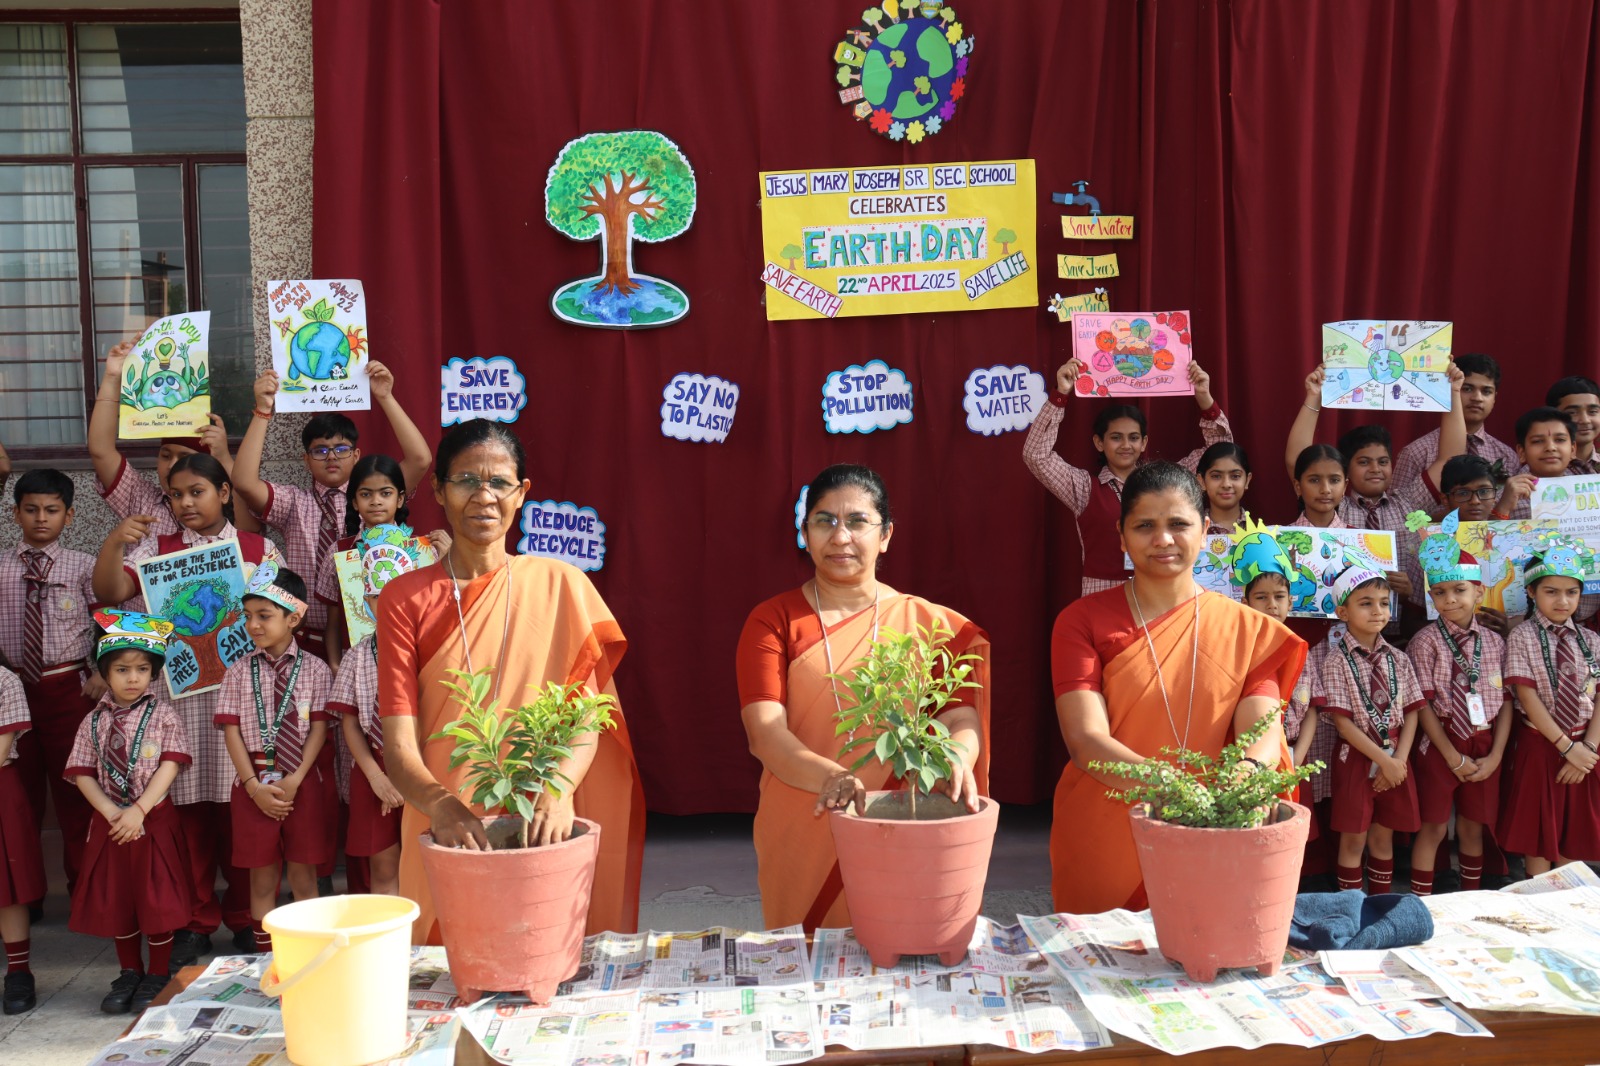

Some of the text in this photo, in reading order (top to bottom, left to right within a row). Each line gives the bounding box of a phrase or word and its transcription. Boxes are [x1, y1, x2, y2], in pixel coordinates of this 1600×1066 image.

[766, 164, 1015, 196] JESUS MARY JOSEPH SR. SEC. SCHOOL
[850, 196, 946, 215] CELEBRATES
[1064, 217, 1132, 237] Save Water
[803, 223, 986, 270] EARTH DAY
[965, 253, 1030, 299] SAVE LIFE
[1061, 256, 1085, 277] Save
[269, 279, 291, 302] HAPPY
[762, 263, 842, 317] SAVE EARTH
[868, 271, 921, 292] APRIL
[921, 273, 955, 290] 2025
[275, 282, 306, 313] EARTH
[337, 297, 354, 313] 22
[179, 317, 202, 345] Day
[1078, 331, 1097, 339] EARTH
[1080, 318, 1101, 328] SAVE
[460, 365, 509, 388] SAVE
[838, 373, 888, 394] STOP
[974, 372, 1027, 397] SAVE
[1105, 376, 1169, 389] HAPPY EARTH DAY
[447, 392, 522, 412] ENERGY
[673, 380, 735, 409] SAY NO
[826, 393, 912, 418] POLLUTION
[976, 394, 1033, 418] WATER
[667, 403, 734, 434] TO PLASTIC
[1574, 482, 1600, 494] EART
[1575, 493, 1600, 511] DA
[530, 507, 596, 534] REDUCE
[1560, 517, 1573, 525] AN'T
[372, 548, 409, 568] EARTH
[527, 532, 599, 560] RECYCLE
[141, 547, 231, 574] TREES ARE THE ROOT
[150, 576, 159, 586] OF
[181, 556, 237, 577] EXISTENCE
[1297, 556, 1323, 578] PLANET
[220, 626, 248, 656] SAV
[1539, 629, 1548, 648] SCHOOL
[168, 649, 193, 673] SAVE
[172, 661, 198, 685] TREE
[276, 707, 286, 722] JESUS
[282, 692, 291, 707] MARY
[288, 673, 297, 692] JOSEPH
[132, 744, 140, 759] JESUS
[136, 727, 144, 744] MARY
